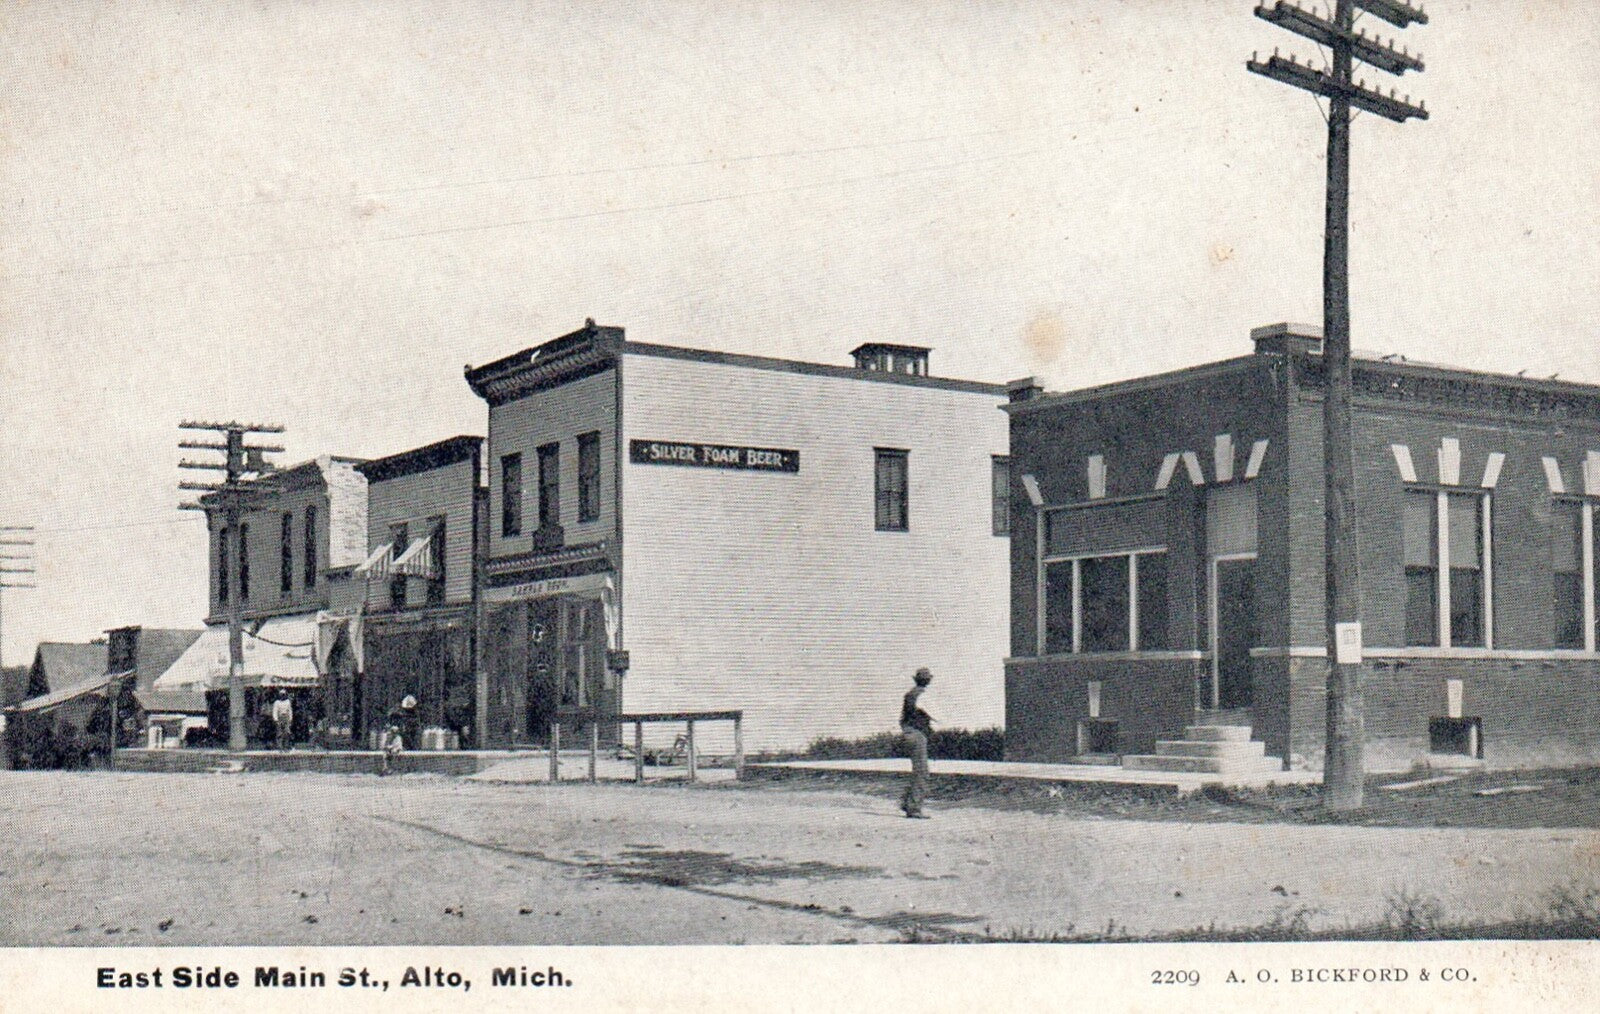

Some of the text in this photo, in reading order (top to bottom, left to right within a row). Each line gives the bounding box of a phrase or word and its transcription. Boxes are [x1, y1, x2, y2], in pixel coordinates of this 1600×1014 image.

[650, 443, 783, 467] SILVER FOAM BEER
